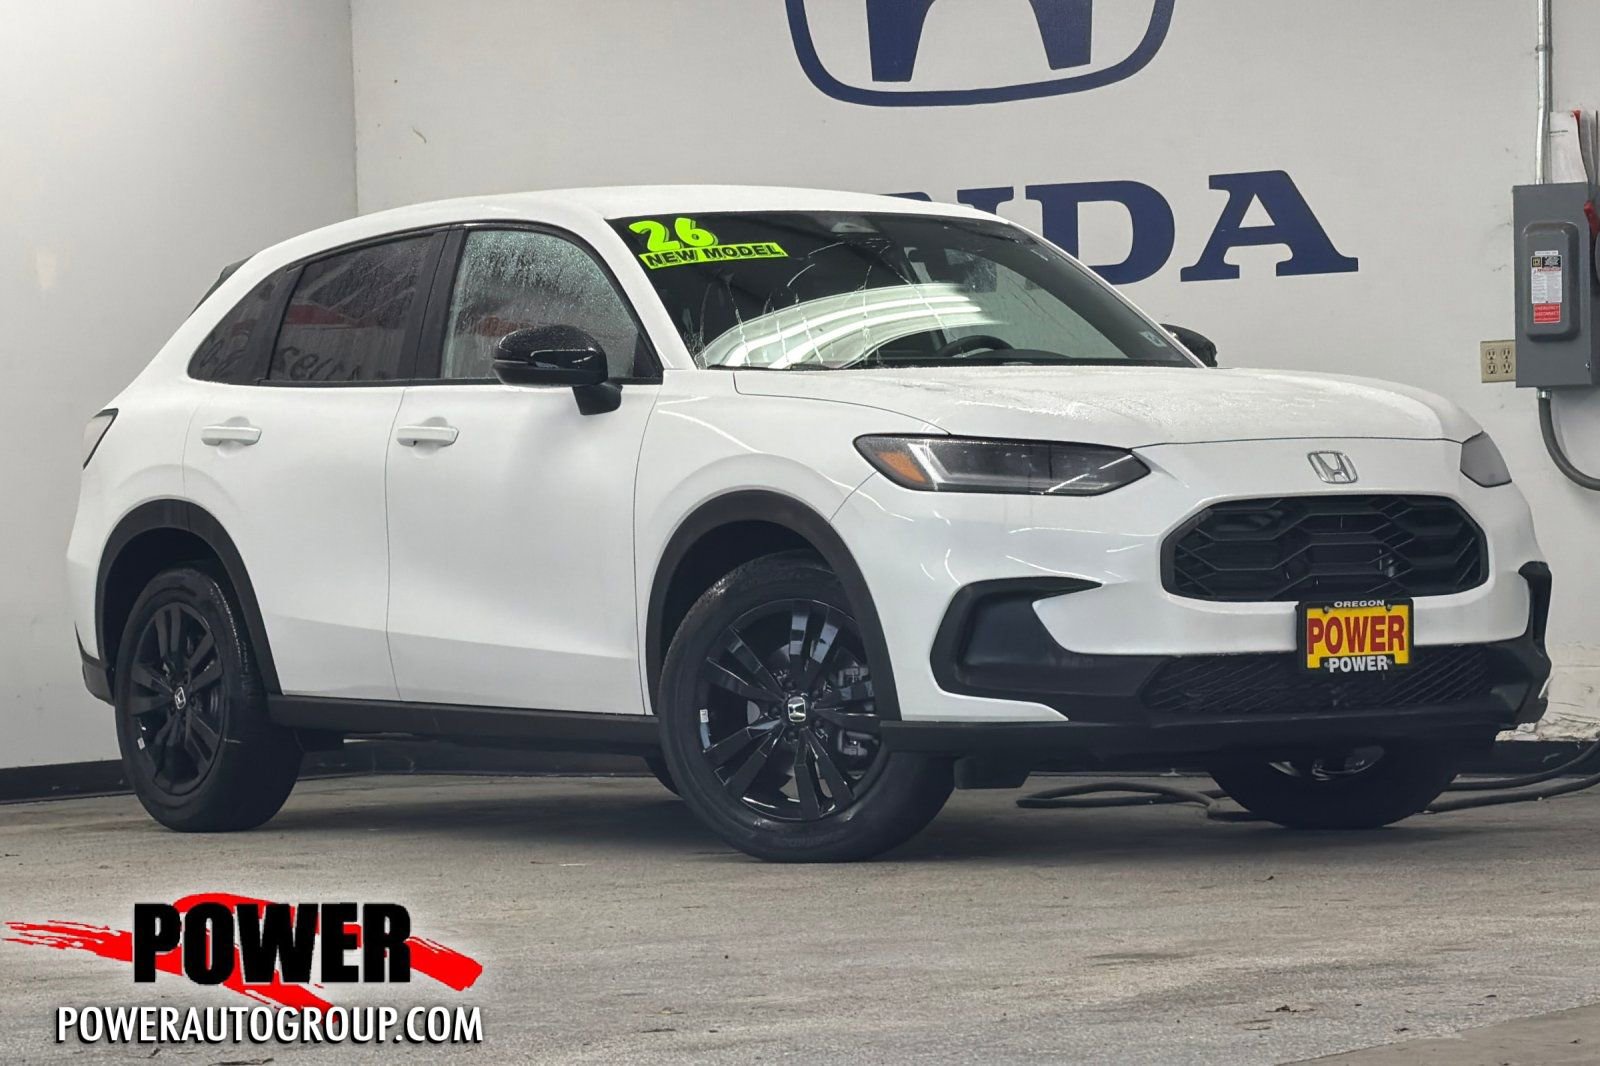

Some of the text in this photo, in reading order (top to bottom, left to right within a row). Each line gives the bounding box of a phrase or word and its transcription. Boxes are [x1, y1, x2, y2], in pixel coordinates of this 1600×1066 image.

[629, 217, 718, 252] 26
[644, 244, 783, 267] NEW MODEL
[1334, 599, 1385, 608] OREGON
[1308, 614, 1405, 655] POWER
[1329, 655, 1389, 673] POWER
